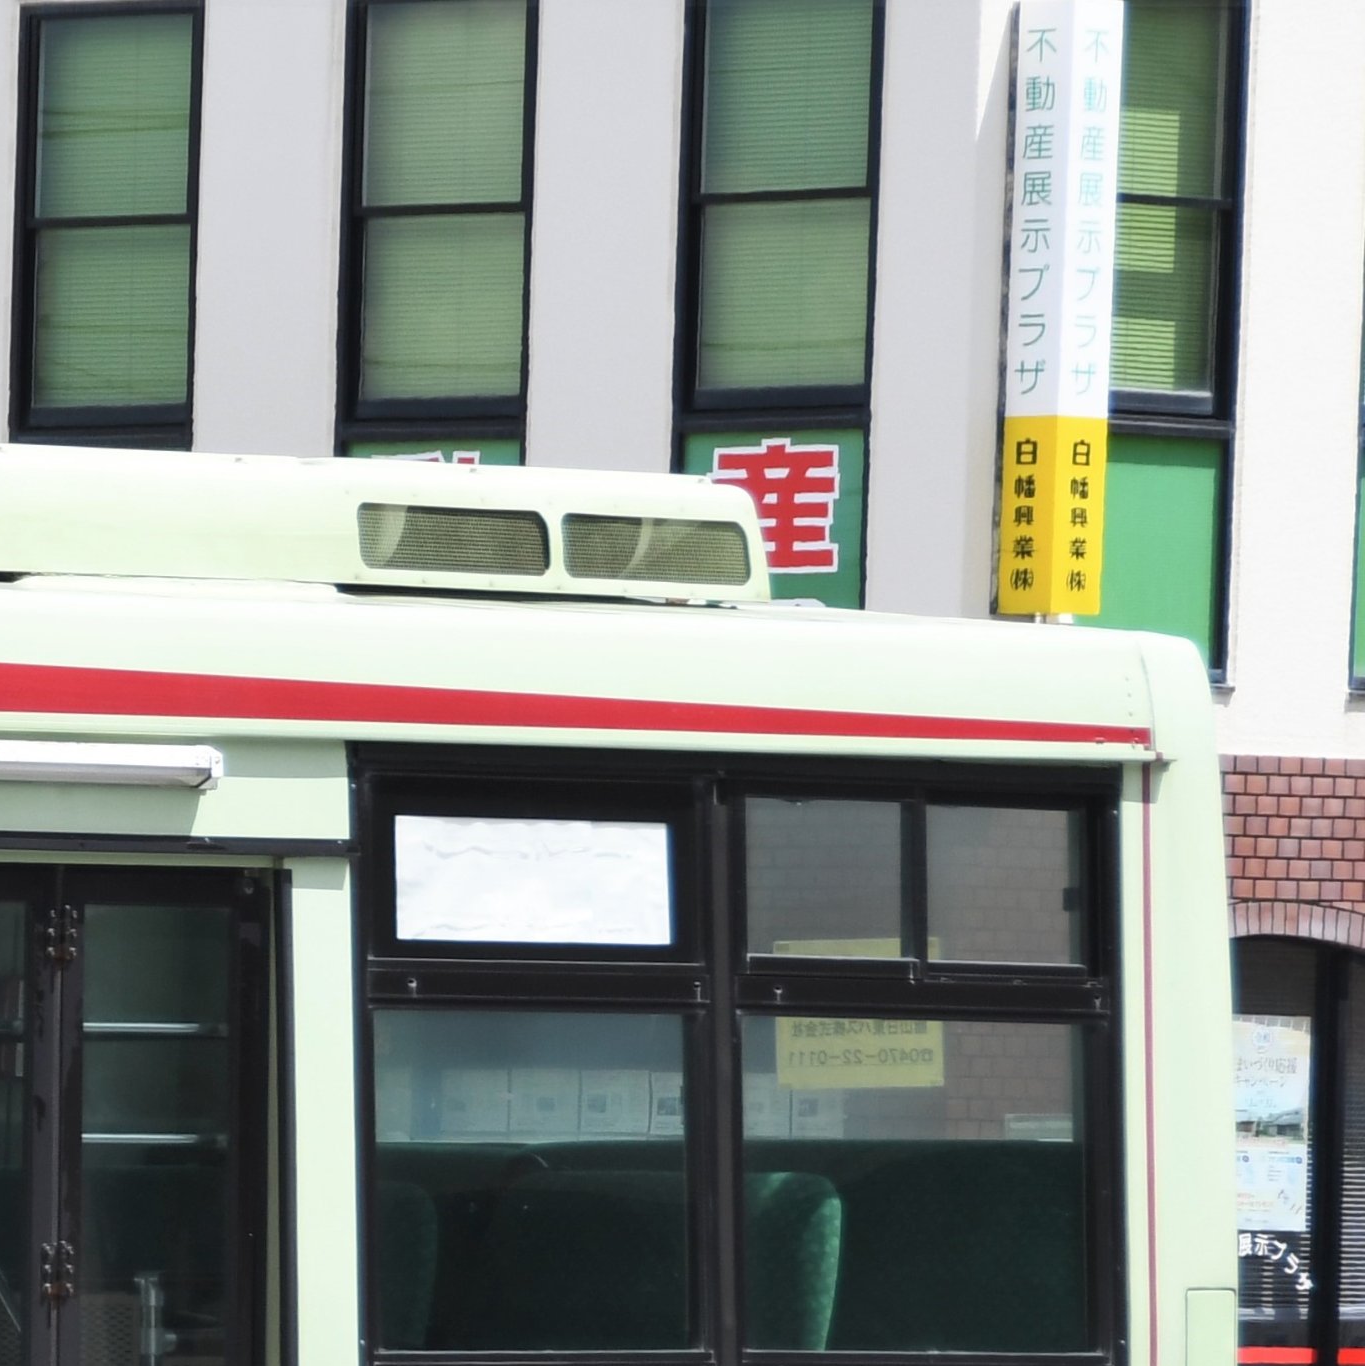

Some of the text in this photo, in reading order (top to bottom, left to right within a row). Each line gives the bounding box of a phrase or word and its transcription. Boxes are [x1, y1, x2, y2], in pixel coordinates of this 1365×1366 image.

[1014, 27, 1059, 396] 不動産展示プラザ
[1070, 27, 1111, 397] 不動産展示プラザ
[711, 438, 841, 573] 産
